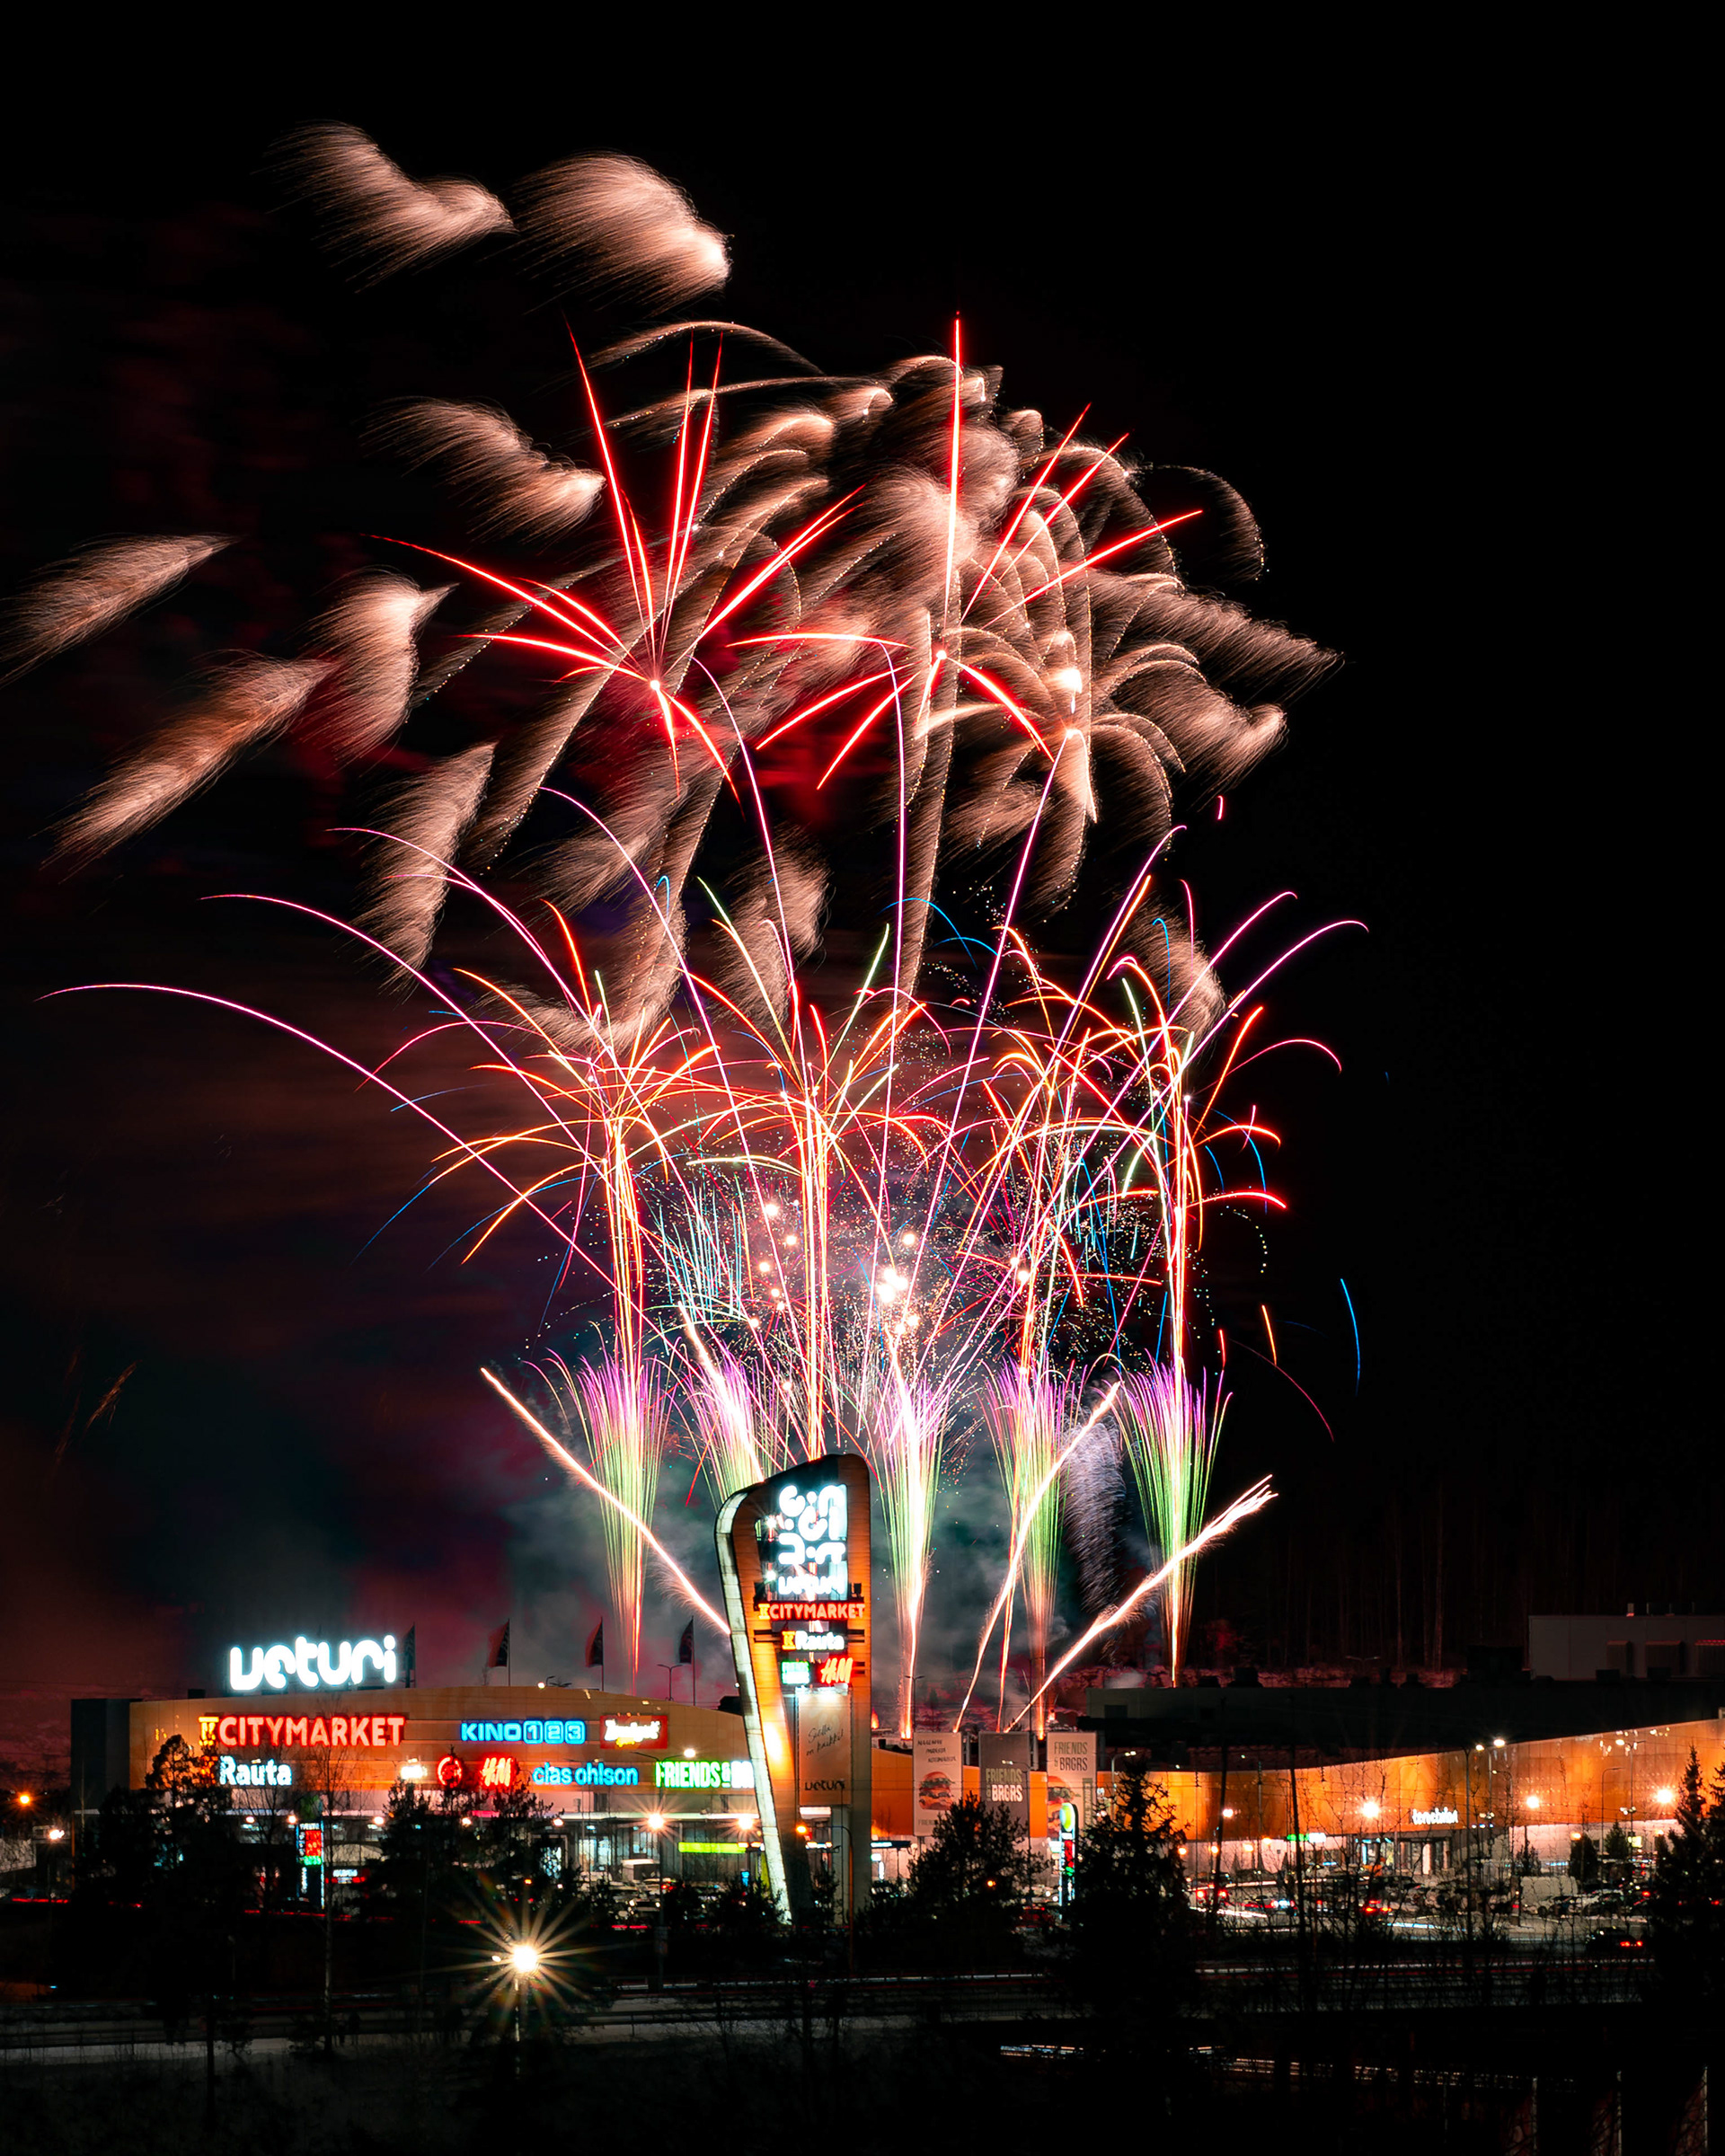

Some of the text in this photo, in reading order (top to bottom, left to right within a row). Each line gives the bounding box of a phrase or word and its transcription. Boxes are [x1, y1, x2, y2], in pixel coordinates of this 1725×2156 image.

[770, 1604, 865, 1620] CITYMARKET
[795, 1630, 845, 1650] Rauta
[820, 1657, 853, 1683] H&M
[219, 1716, 404, 1746] CITYMARKET
[1054, 1742, 1088, 1754] FRIENDS
[219, 1755, 293, 1786] Rauta
[532, 1762, 639, 1786] clas ohlson
[1059, 1757, 1088, 1771] BRGRS
[656, 1762, 721, 1788] FRIENDS
[986, 1768, 1022, 1783] FRIENDS
[991, 1784, 1023, 1802] BRGRS
